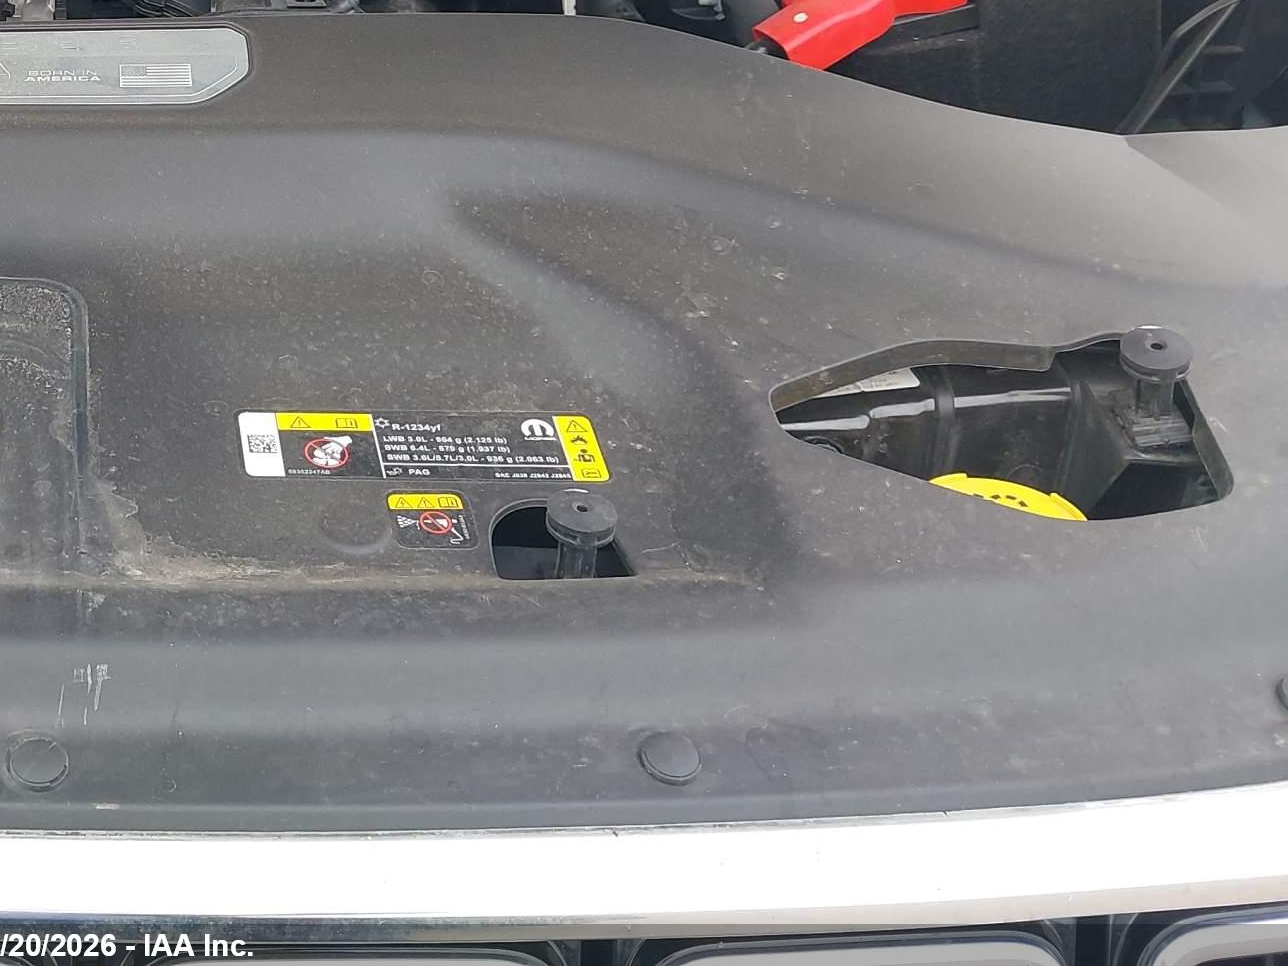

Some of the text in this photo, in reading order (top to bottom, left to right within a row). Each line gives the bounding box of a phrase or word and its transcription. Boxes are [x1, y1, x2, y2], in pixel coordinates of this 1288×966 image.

[391, 423, 442, 433] R-1234yf
[382, 435, 409, 443] LWB
[454, 437, 462, 445] g
[463, 436, 492, 444] (2.125
[494, 436, 508, 444] lb)
[497, 445, 511, 453] lb)
[506, 456, 513, 464] g
[545, 455, 560, 464] lb)
[408, 468, 431, 476] PAG
